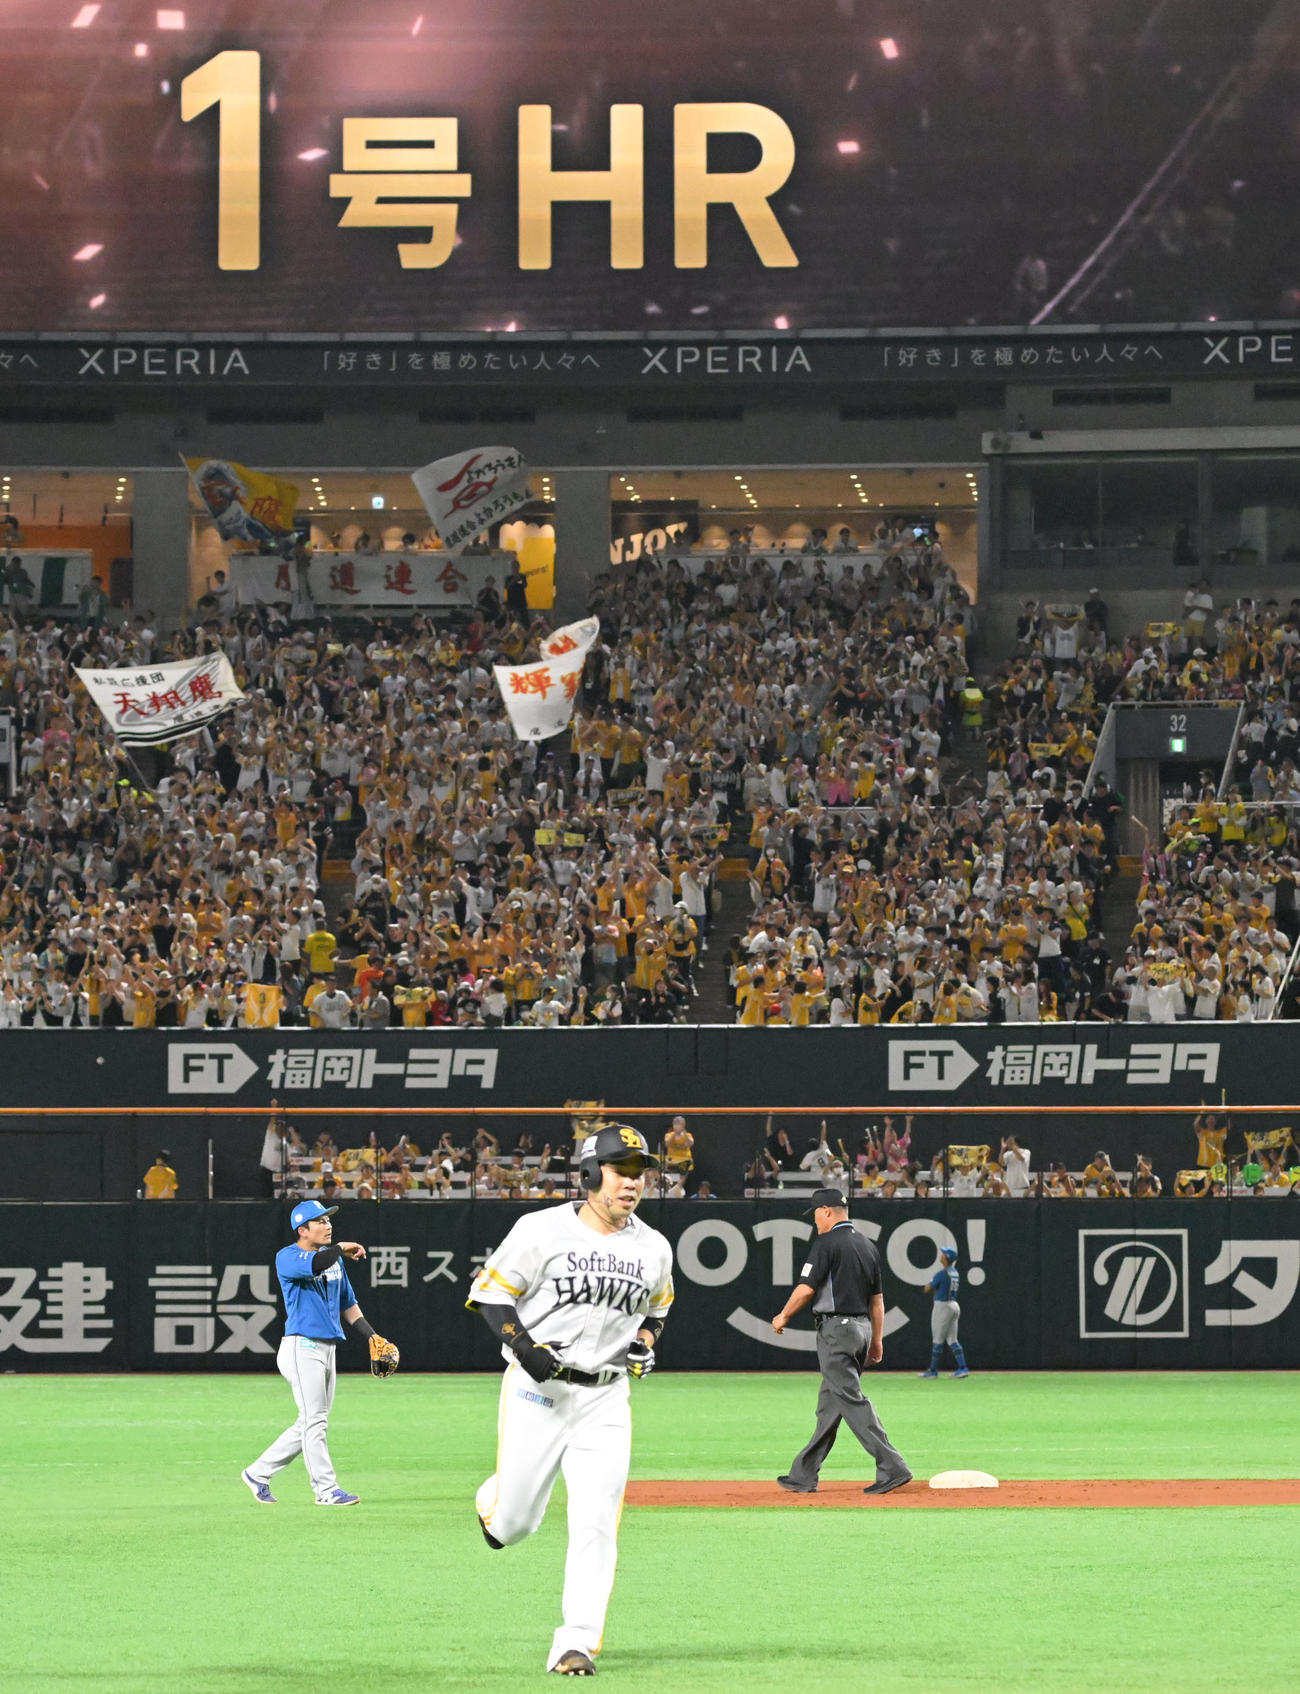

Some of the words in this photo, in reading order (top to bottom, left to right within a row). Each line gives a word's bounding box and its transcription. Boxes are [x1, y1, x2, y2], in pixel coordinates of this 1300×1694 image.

[78, 347, 249, 376] XPERIA
[321, 350, 601, 371] 「好き」を極めたい人々へ
[641, 345, 811, 374] XPERIA
[883, 344, 1163, 368] 「好き」を極めたい人々へ
[113, 673, 223, 716] 天翔鷹
[1169, 714, 1187, 732] 32
[183, 1053, 234, 1083] FT
[266, 1049, 499, 1089] 福岡トヨタ
[903, 1050, 954, 1081] FT
[985, 1043, 1221, 1086] 福岡トヨタ
